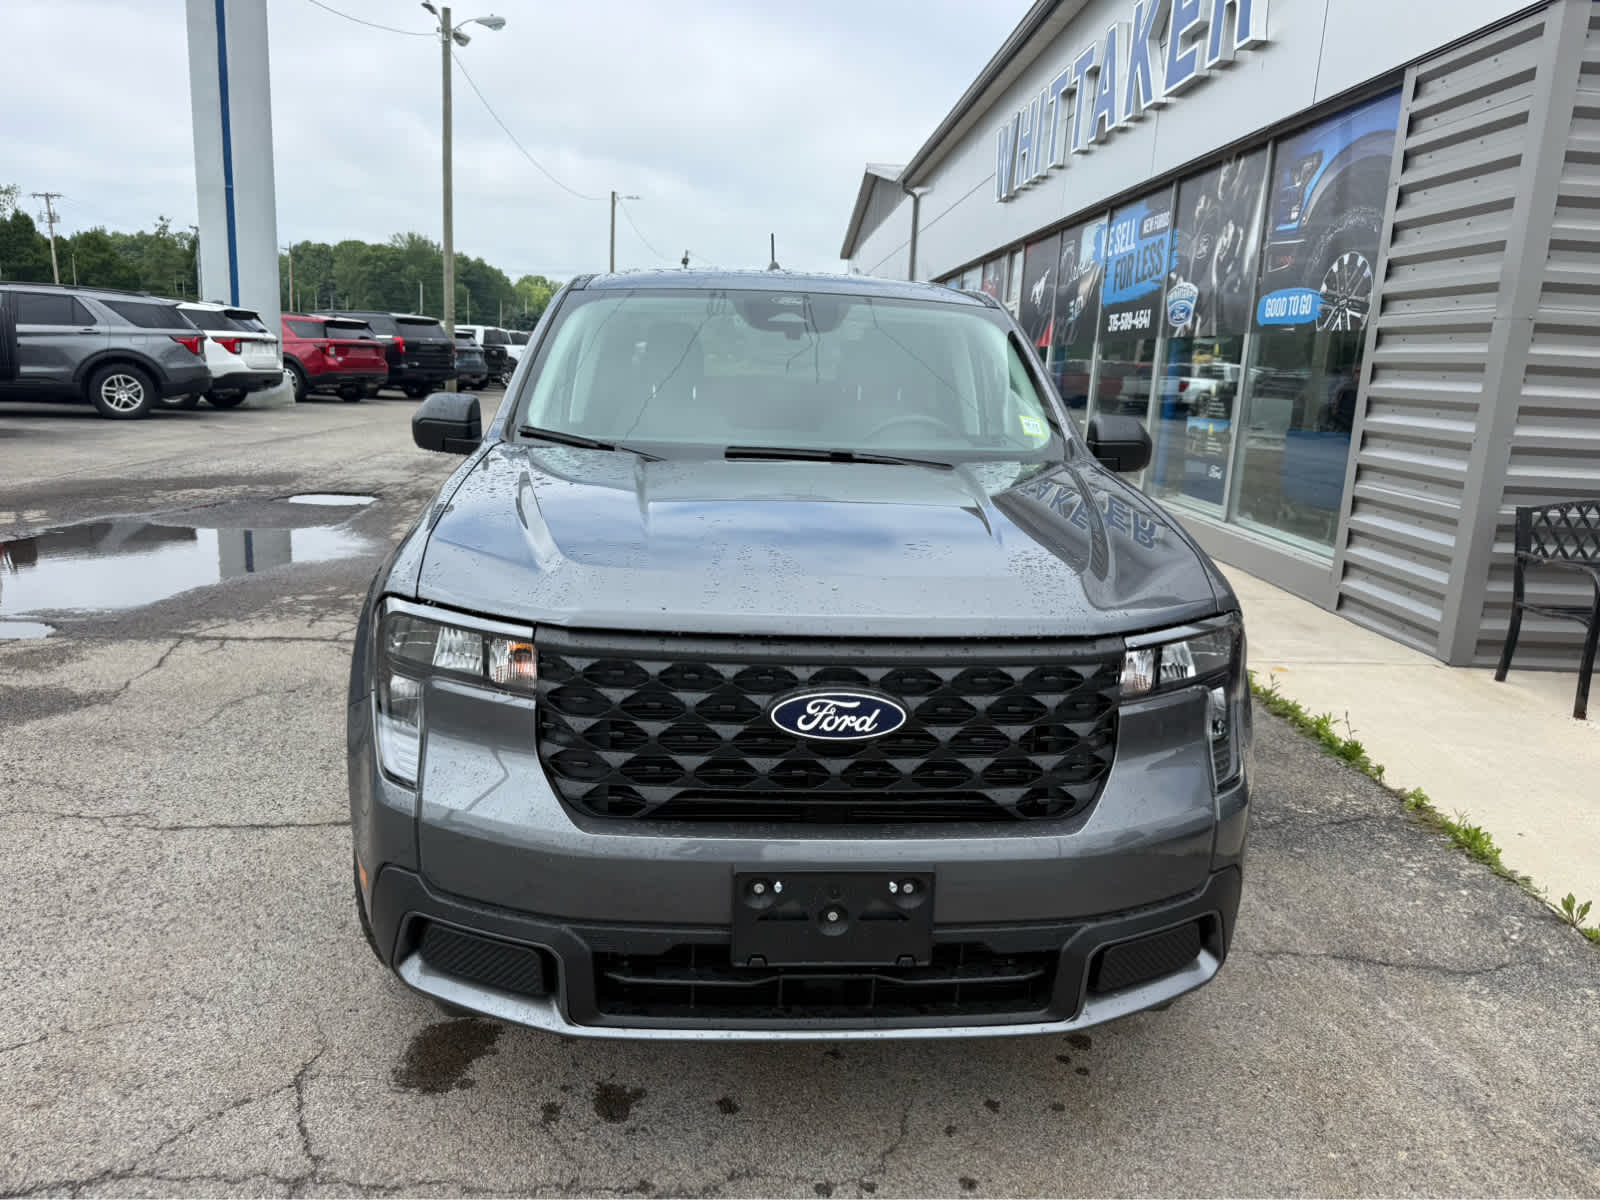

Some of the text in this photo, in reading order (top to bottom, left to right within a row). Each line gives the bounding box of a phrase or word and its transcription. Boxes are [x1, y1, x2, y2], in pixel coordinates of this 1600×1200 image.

[1115, 219, 1135, 254] SELL
[1114, 252, 1133, 293] FOR
[1136, 238, 1163, 283] LESS
[1265, 294, 1312, 317] GOOD TO GO
[797, 698, 881, 732] Ford
